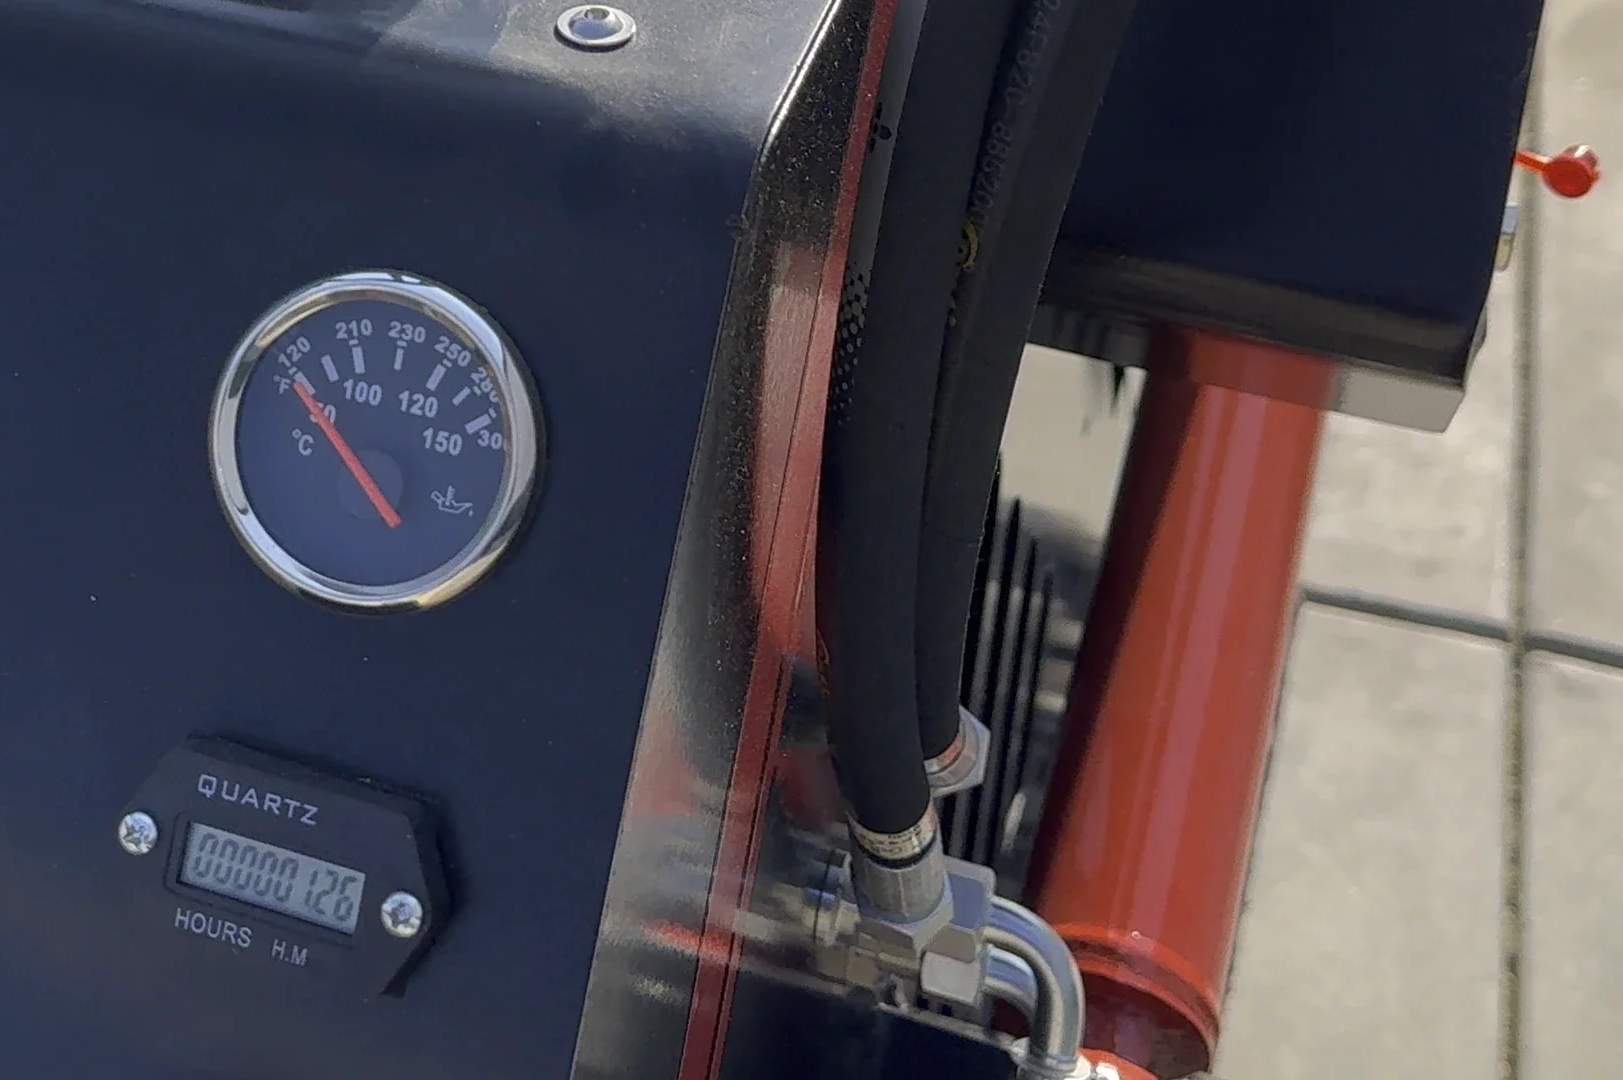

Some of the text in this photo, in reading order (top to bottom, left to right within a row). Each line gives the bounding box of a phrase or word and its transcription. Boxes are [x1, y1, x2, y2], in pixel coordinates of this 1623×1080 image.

[335, 319, 373, 340] 210
[388, 320, 426, 344] 230
[278, 336, 311, 367] 120
[433, 336, 471, 367] 250
[342, 379, 383, 406] 100
[398, 391, 438, 418] 120
[292, 428, 314, 456] °C
[423, 427, 463, 456] 150
[198, 773, 319, 826] QUARTZ
[174, 908, 309, 967] HOURS H.M
